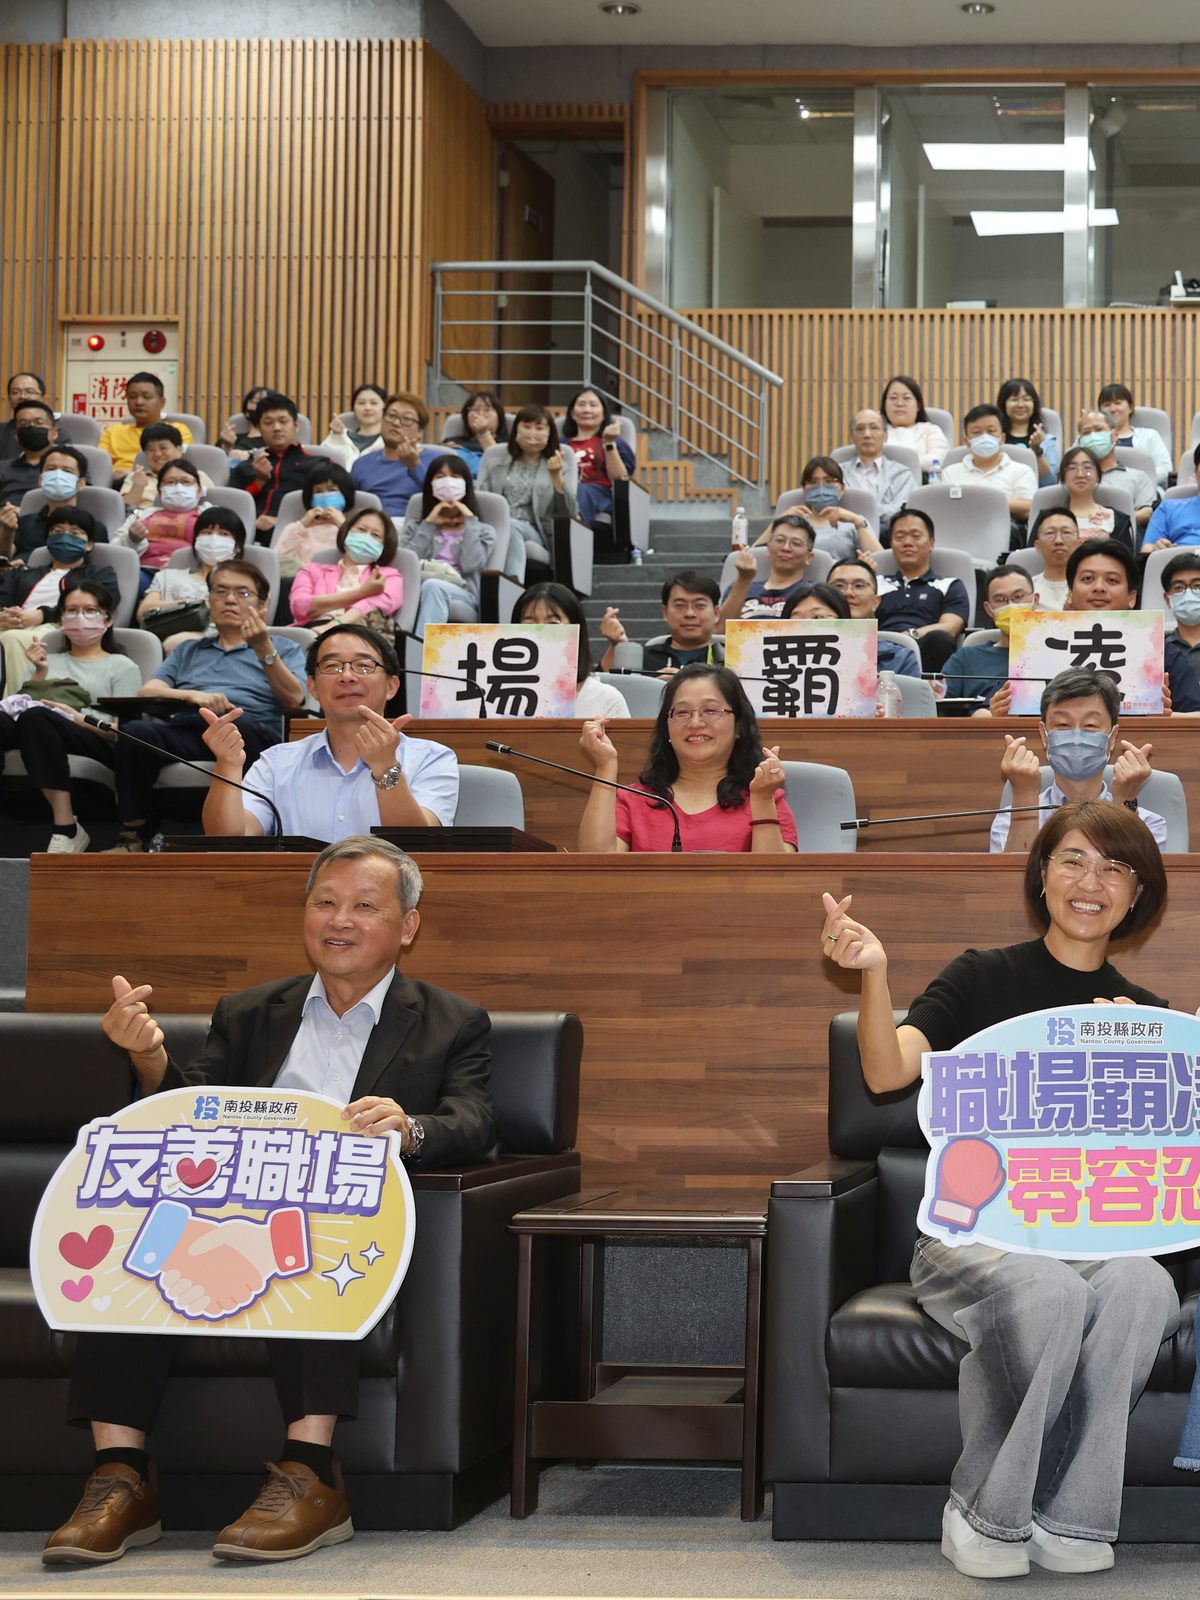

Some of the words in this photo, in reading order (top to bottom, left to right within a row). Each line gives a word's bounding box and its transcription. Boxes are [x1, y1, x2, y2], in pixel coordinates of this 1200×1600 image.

[456, 637, 540, 717] 場
[762, 634, 841, 716] 霸
[1080, 1021, 1164, 1037] 南投縣政府
[223, 1100, 299, 1115] 南投縣政府
[79, 1126, 390, 1210] 友善職場
